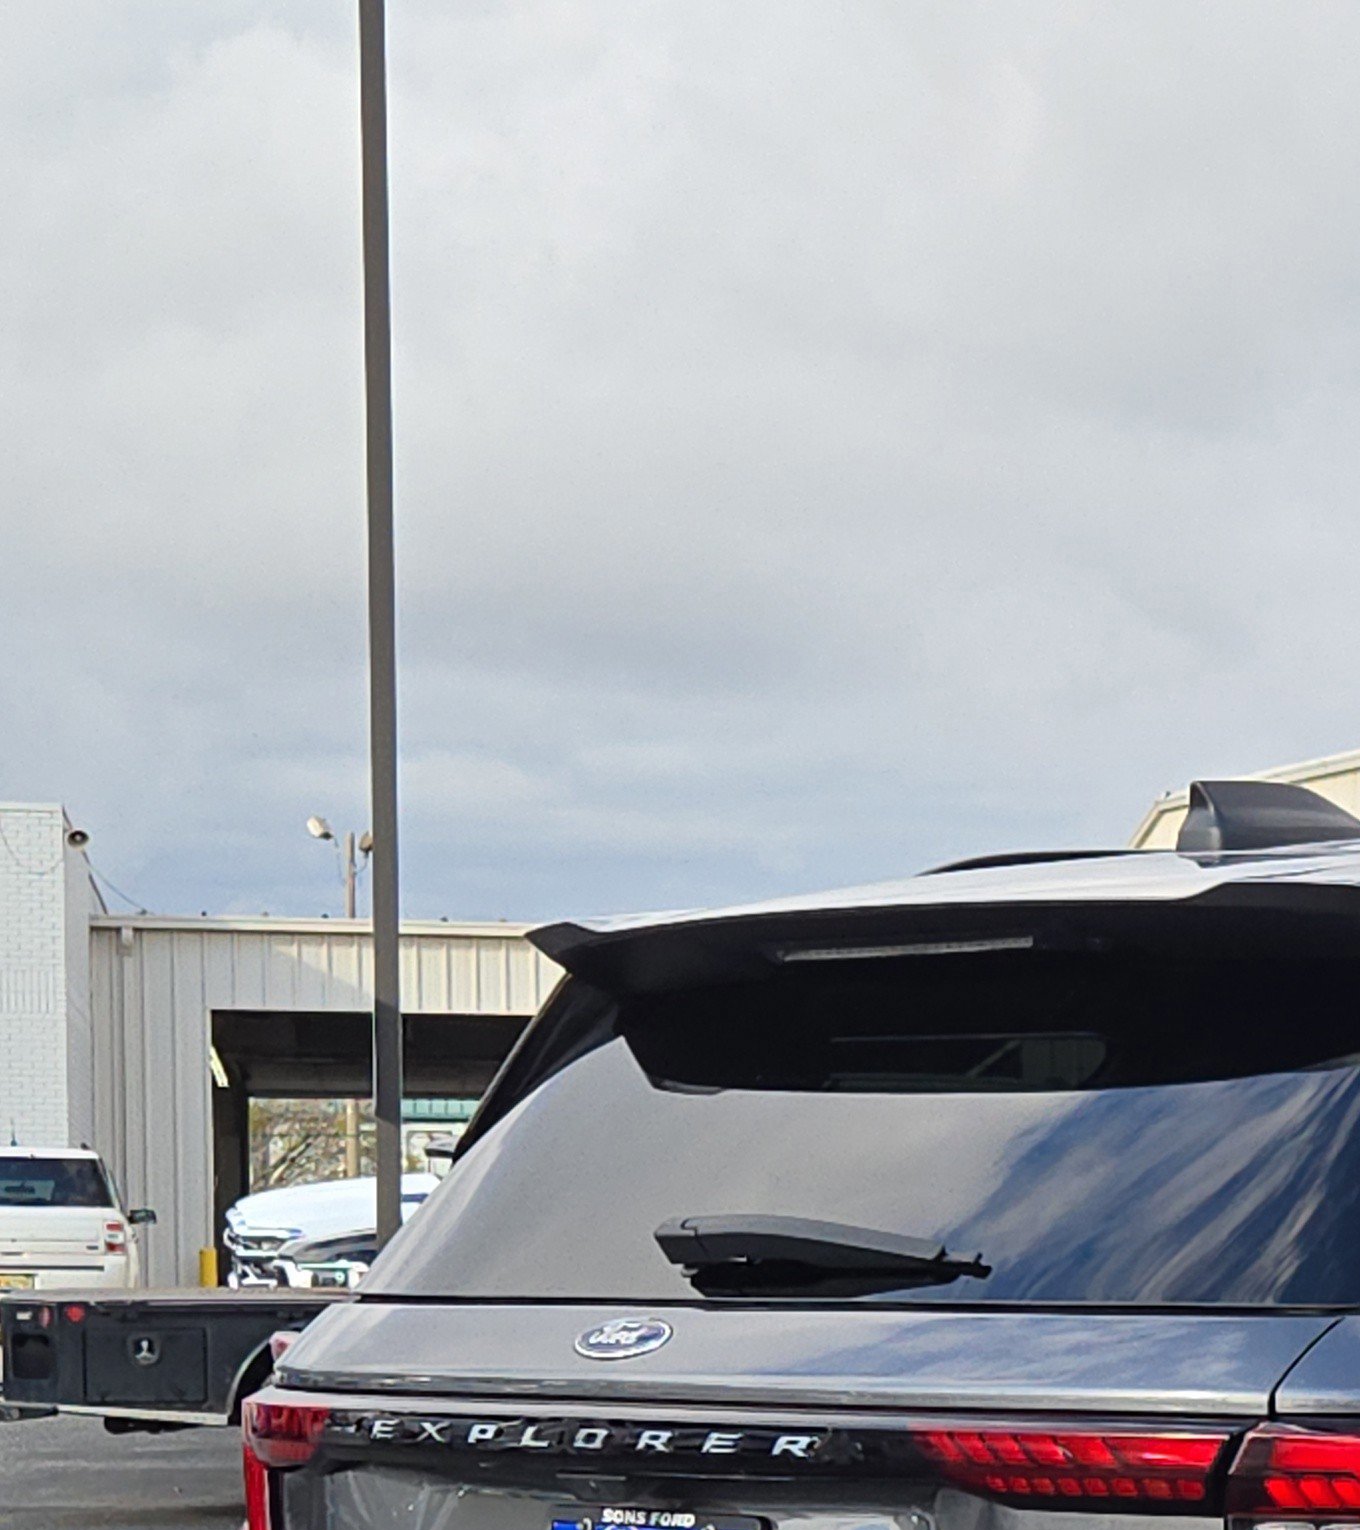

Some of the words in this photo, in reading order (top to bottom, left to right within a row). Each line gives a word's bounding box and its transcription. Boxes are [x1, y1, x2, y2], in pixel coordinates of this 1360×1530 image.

[371, 1418, 811, 1459] EXPLORER
[600, 1507, 647, 1525] SONS
[648, 1511, 696, 1528] FORD
